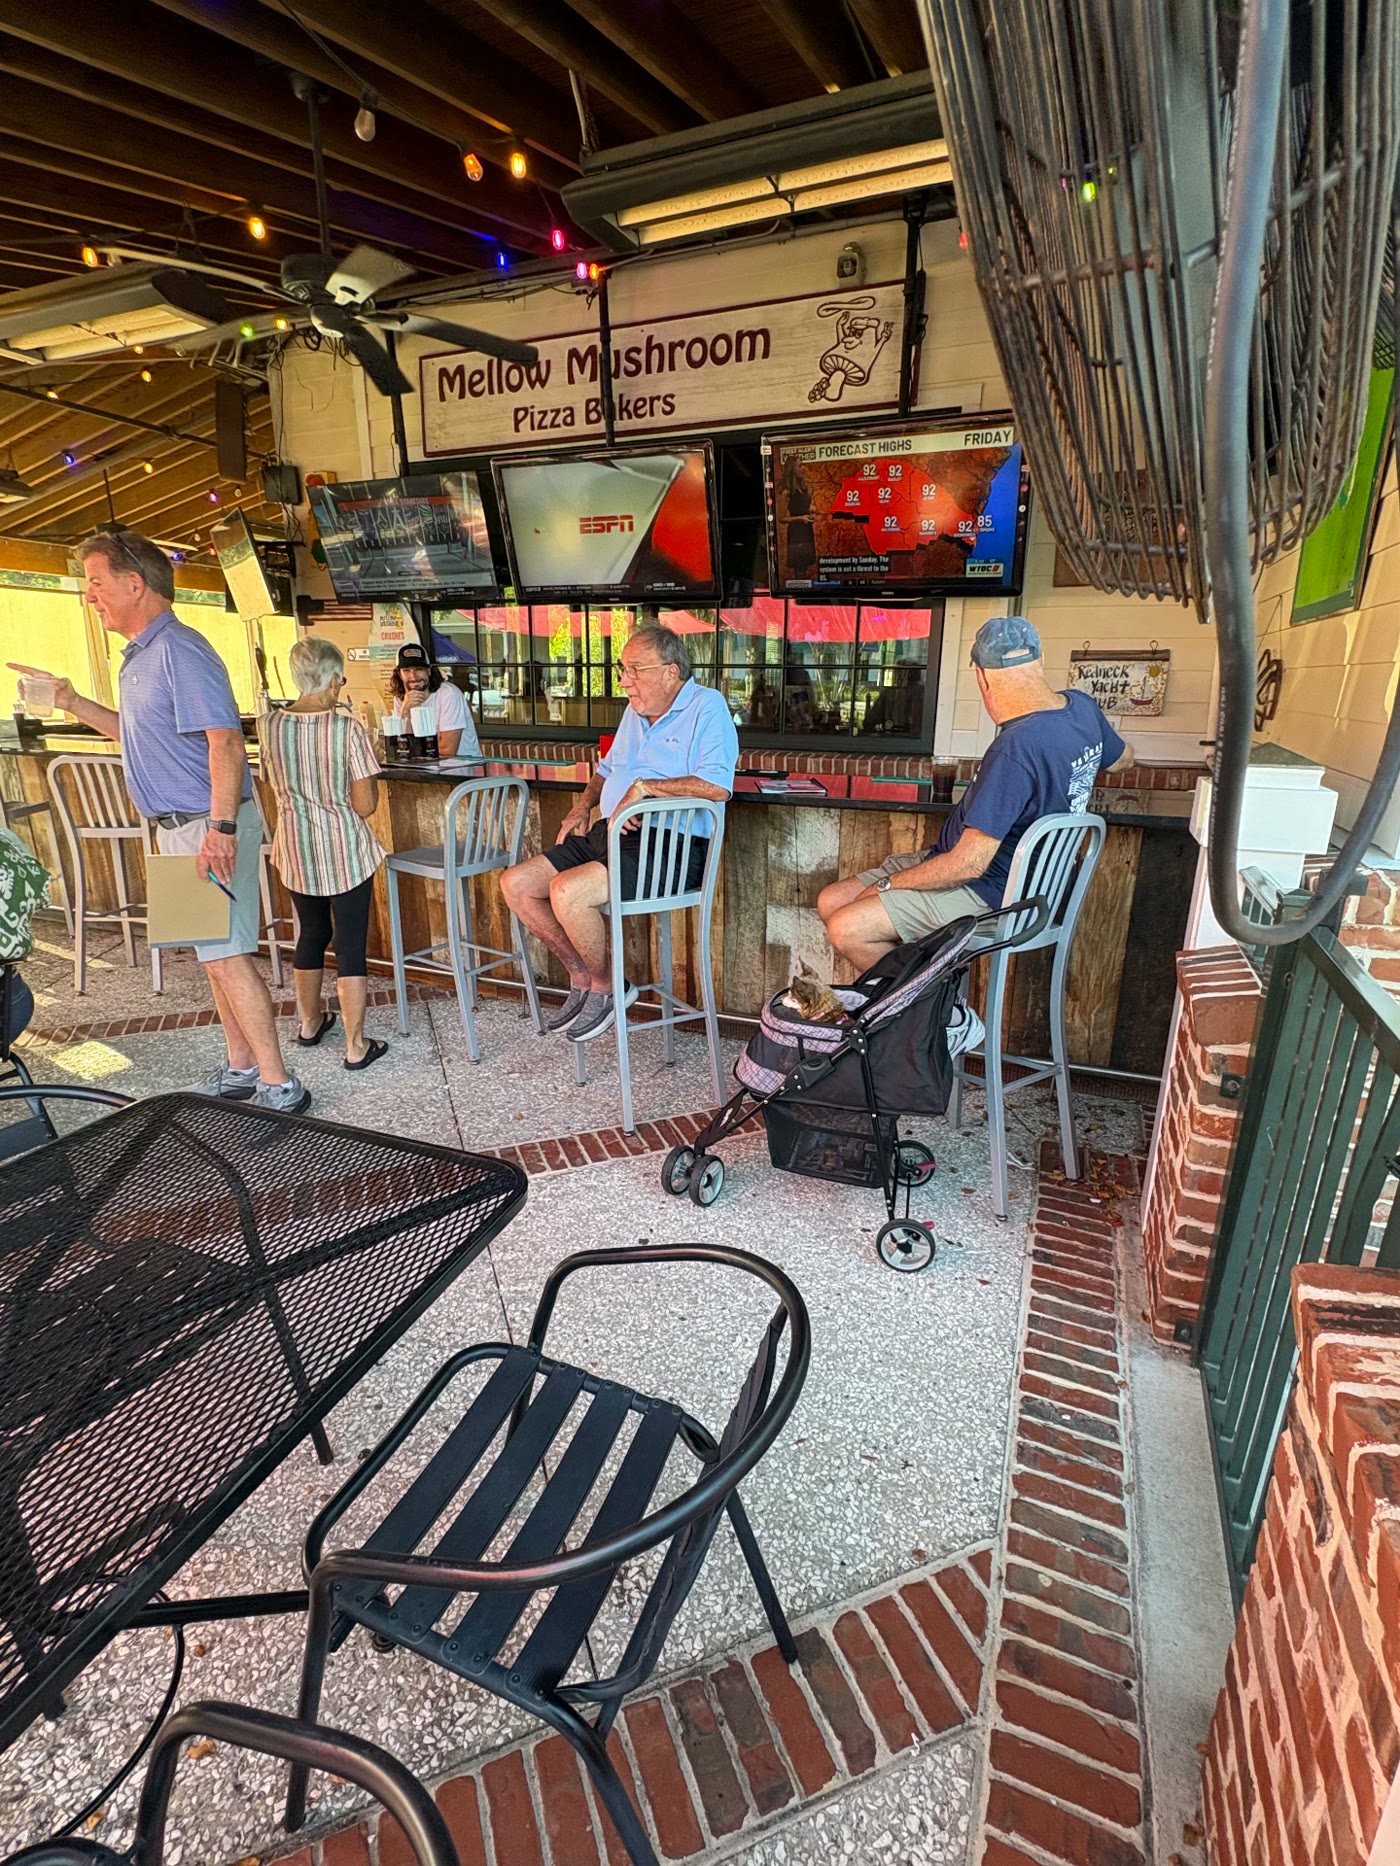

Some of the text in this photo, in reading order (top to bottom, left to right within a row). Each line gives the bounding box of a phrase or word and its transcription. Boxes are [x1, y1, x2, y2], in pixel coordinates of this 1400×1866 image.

[438, 358, 551, 402] Mellow
[513, 393, 676, 433] Pizza Bkers
[818, 430, 1012, 459] FORECAST HIGHS FRIDAY
[863, 464, 876, 476] 92
[889, 465, 902, 477] 92
[846, 490, 859, 502] 92
[878, 487, 891, 499] 92
[922, 484, 936, 496] 92
[579, 514, 634, 535] ESPN
[884, 516, 897, 528] 92
[921, 519, 935, 531] 92
[958, 520, 973, 533] 92
[977, 515, 993, 527] 85
[819, 557, 852, 565] development
[819, 566, 837, 574] system
[1094, 696, 1118, 709] UB
